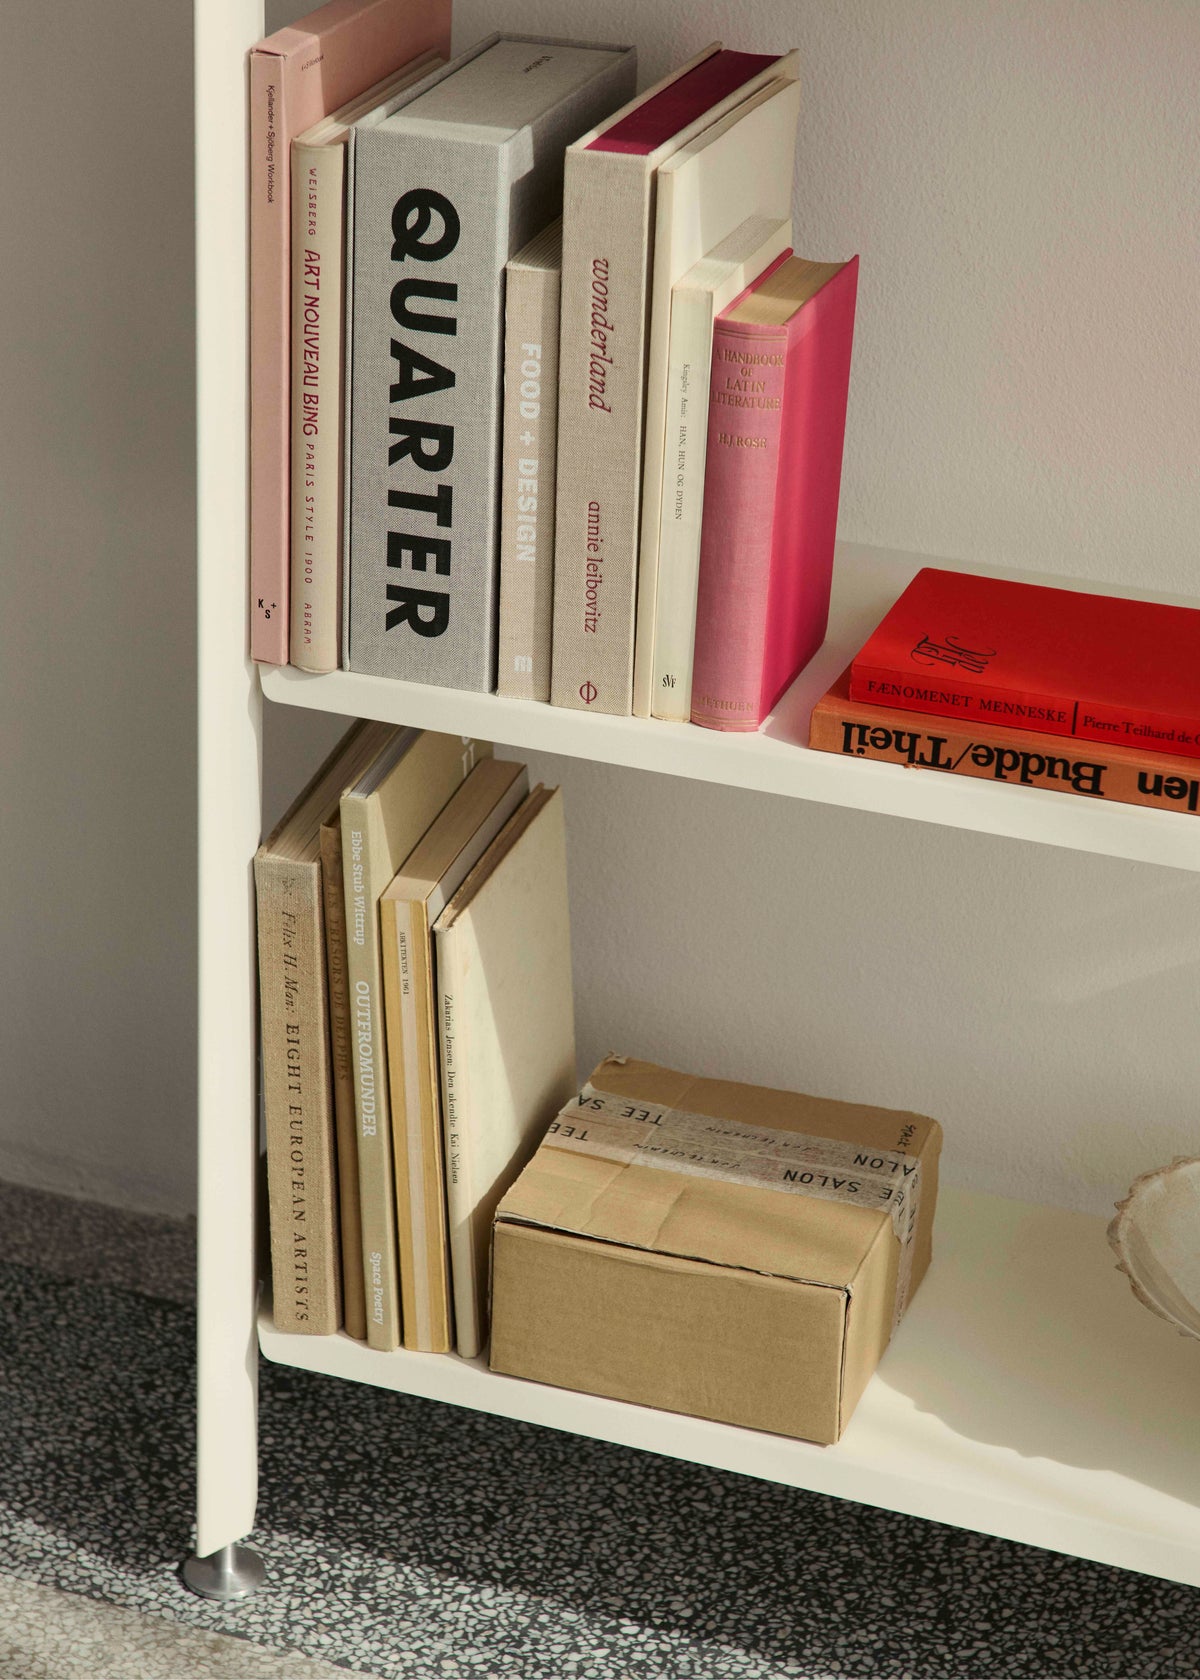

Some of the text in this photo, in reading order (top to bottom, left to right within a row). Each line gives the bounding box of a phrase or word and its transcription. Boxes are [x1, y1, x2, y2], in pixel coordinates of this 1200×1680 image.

[266, 85, 275, 125] Kjellander
[266, 131, 276, 162] Sjöberg
[267, 163, 275, 203] Workbook
[308, 168, 317, 235] WEISBERG
[304, 249, 321, 290] ART
[303, 294, 320, 387] NOUVEAU
[724, 349, 784, 367] HANDBOOK
[740, 367, 752, 377] OF
[680, 364, 690, 393] Kingsley
[726, 377, 766, 393] LATIN
[385, 188, 461, 639] QUARTER
[711, 391, 781, 410] LITERATURE
[516, 342, 541, 562] FOOD + DESIGN
[584, 258, 614, 633] wonderland annie leibovitz
[678, 425, 687, 447] HAN,
[736, 437, 767, 449] ROSE
[305, 443, 315, 487] PARIS
[677, 450, 686, 470] HUN
[676, 474, 685, 487] OG
[305, 496, 314, 542] STYLE
[675, 490, 684, 520] DYDEN
[304, 552, 313, 584] 1900
[258, 599, 264, 608] K
[264, 609, 271, 619] S
[303, 602, 313, 651] ABRAM
[868, 680, 973, 708] FÆNOMENET
[979, 699, 1067, 724] MENNESKE
[1083, 715, 1120, 732] Pierre
[1122, 721, 1175, 741] Teilhard
[1178, 731, 1192, 744] de
[284, 955, 297, 971] H.
[284, 976, 298, 1014] Man:
[402, 978, 410, 995] 1961
[286, 1023, 302, 1094] EIGHT
[351, 830, 384, 1325] Ebbe Stub Wittrup OUTFROMUNDER Space Poetry
[444, 994, 460, 1184] Zakarias Jensen: Den ukendte Kai Nielsen
[548, 1122, 588, 1141] TEE
[621, 1106, 662, 1126] TEE
[288, 1104, 306, 1222] EUROPEAN
[783, 1169, 861, 1193] SALON
[293, 1232, 309, 1321] ARTISTS
